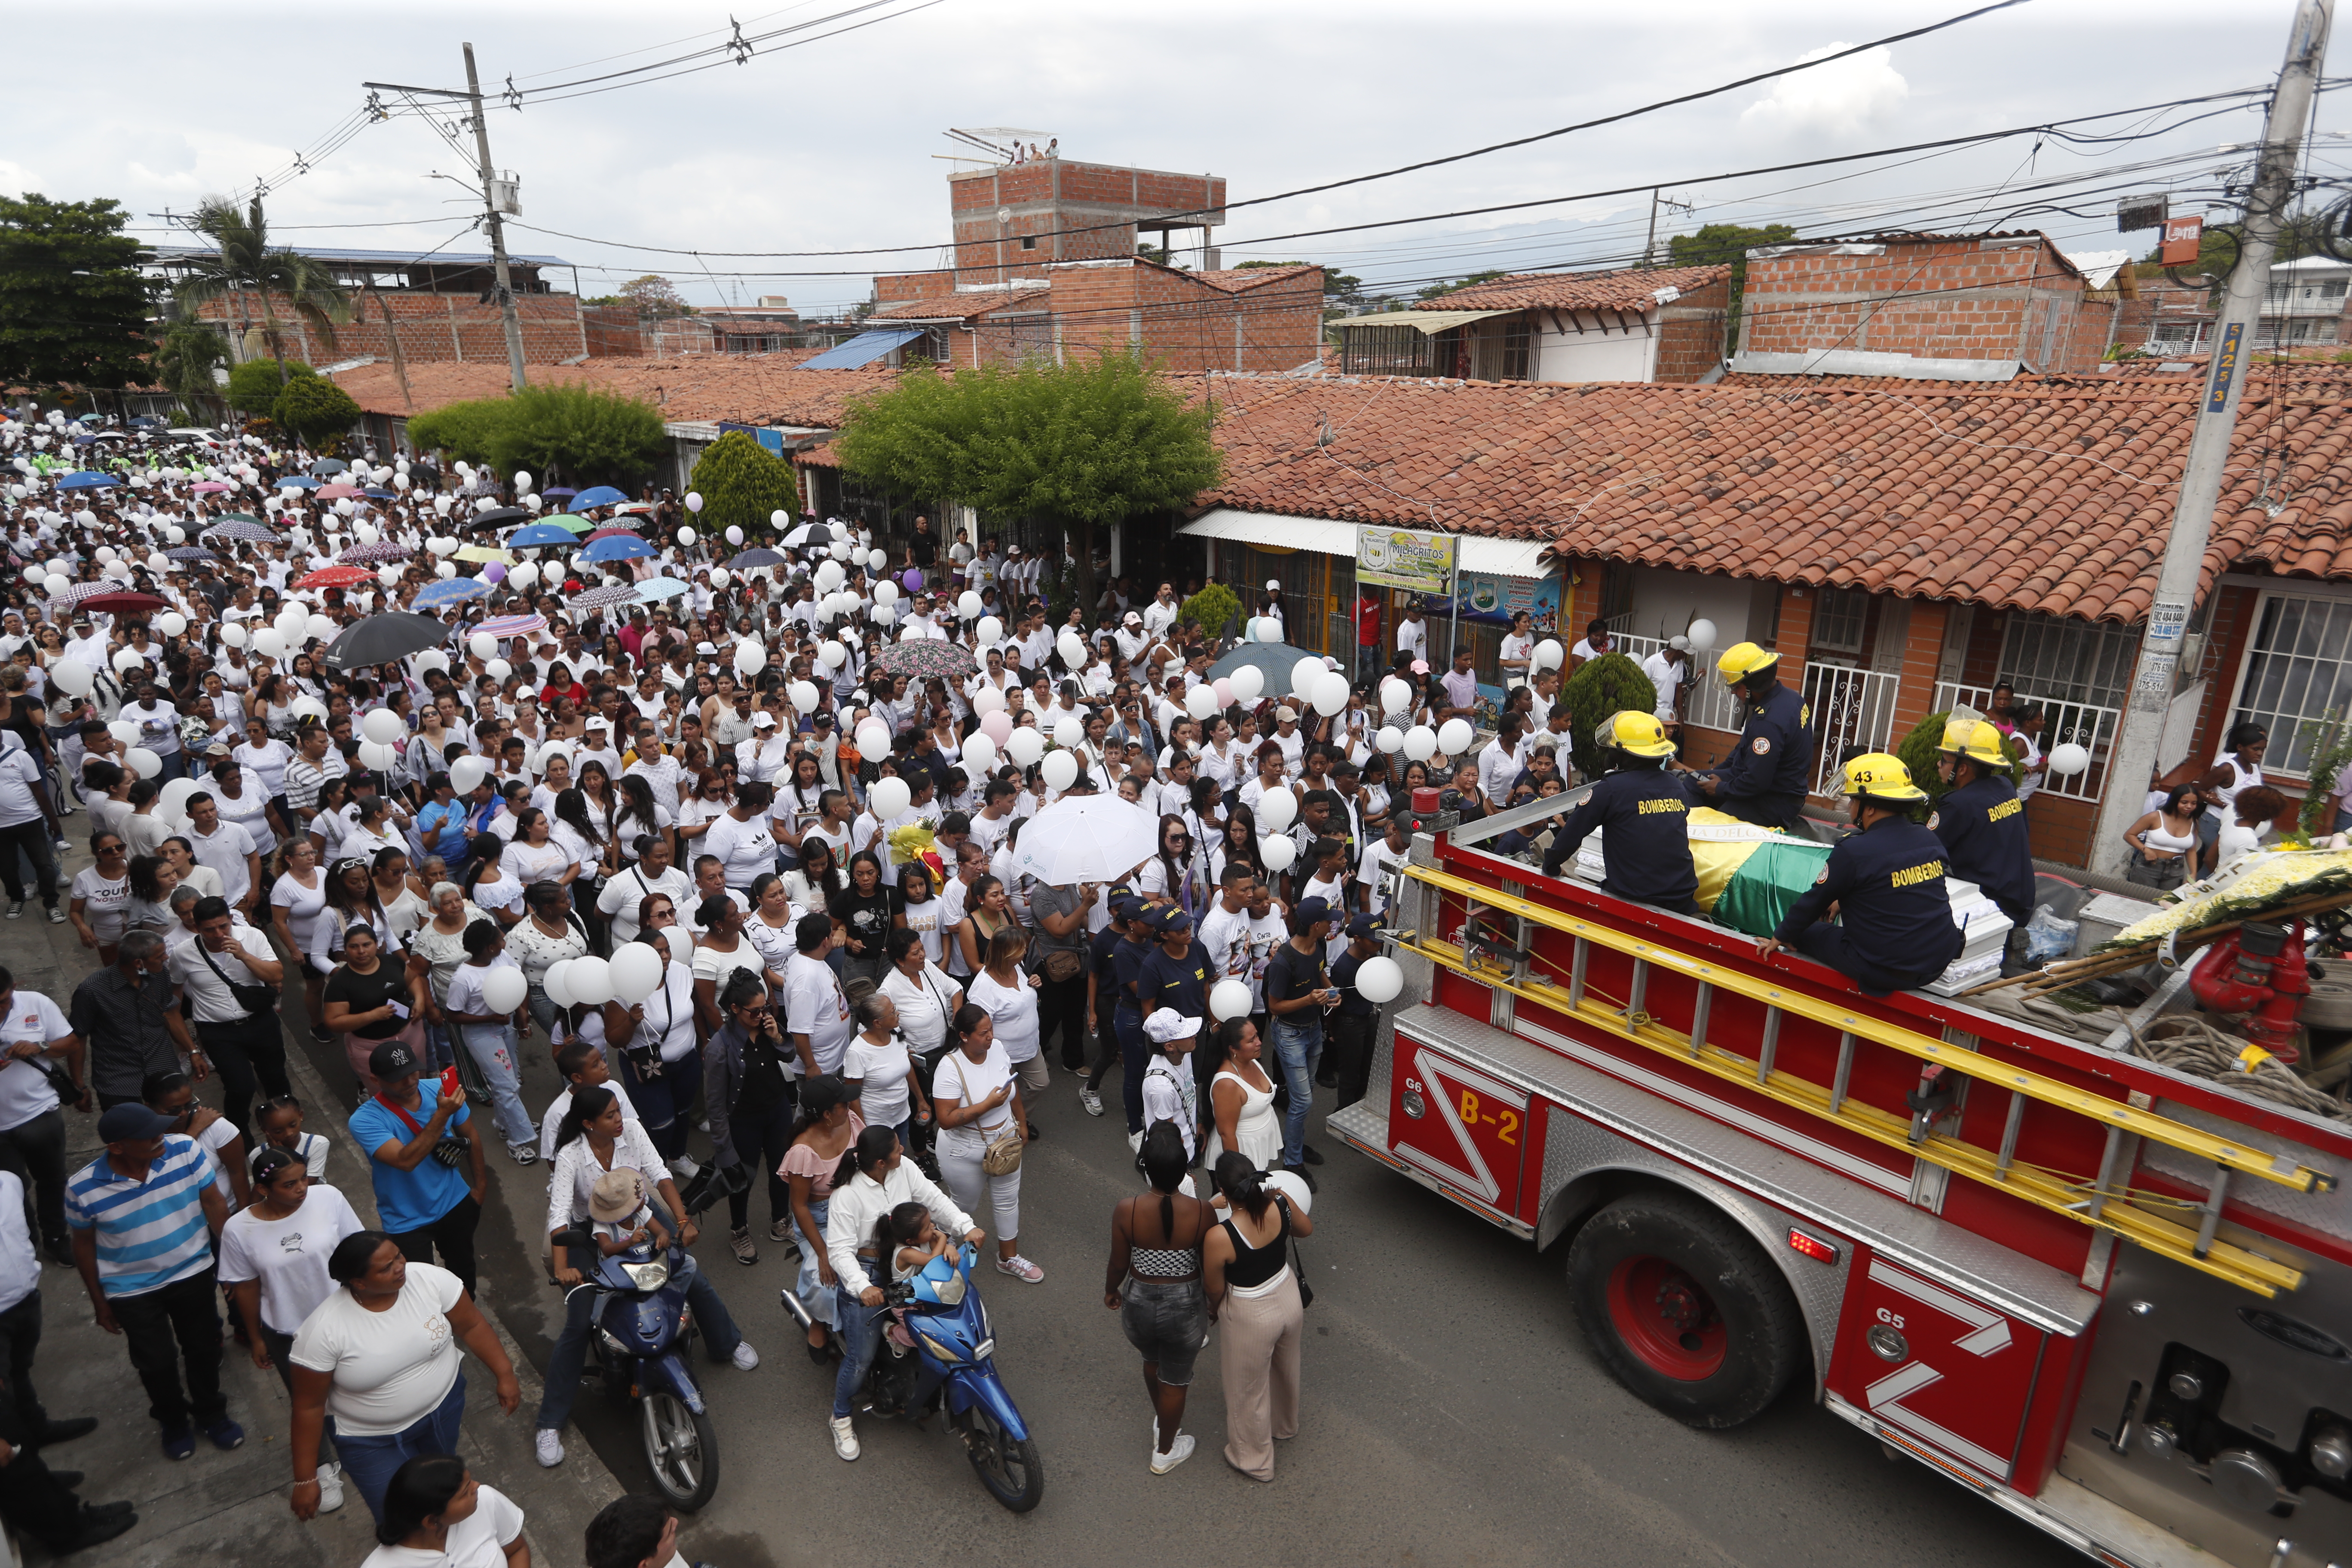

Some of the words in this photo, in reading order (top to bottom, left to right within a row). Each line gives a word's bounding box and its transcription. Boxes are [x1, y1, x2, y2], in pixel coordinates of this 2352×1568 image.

[1393, 544, 1444, 559] MILAGRITOS
[2162, 612, 2172, 622] 484
[1854, 771, 1873, 783] 43
[1638, 798, 1685, 815] BOMBEROS
[1428, 818, 1456, 830] E-ONE
[759, 842, 775, 856] adidas
[1031, 862, 1047, 873] nuestra
[1891, 860, 1944, 888] BOMBEROS
[913, 915, 936, 924] BARE
[1165, 910, 1175, 920] LABOR
[1406, 1078, 1422, 1093] G6
[1460, 1090, 1518, 1146] B-2
[1876, 1308, 1905, 1329] G5
